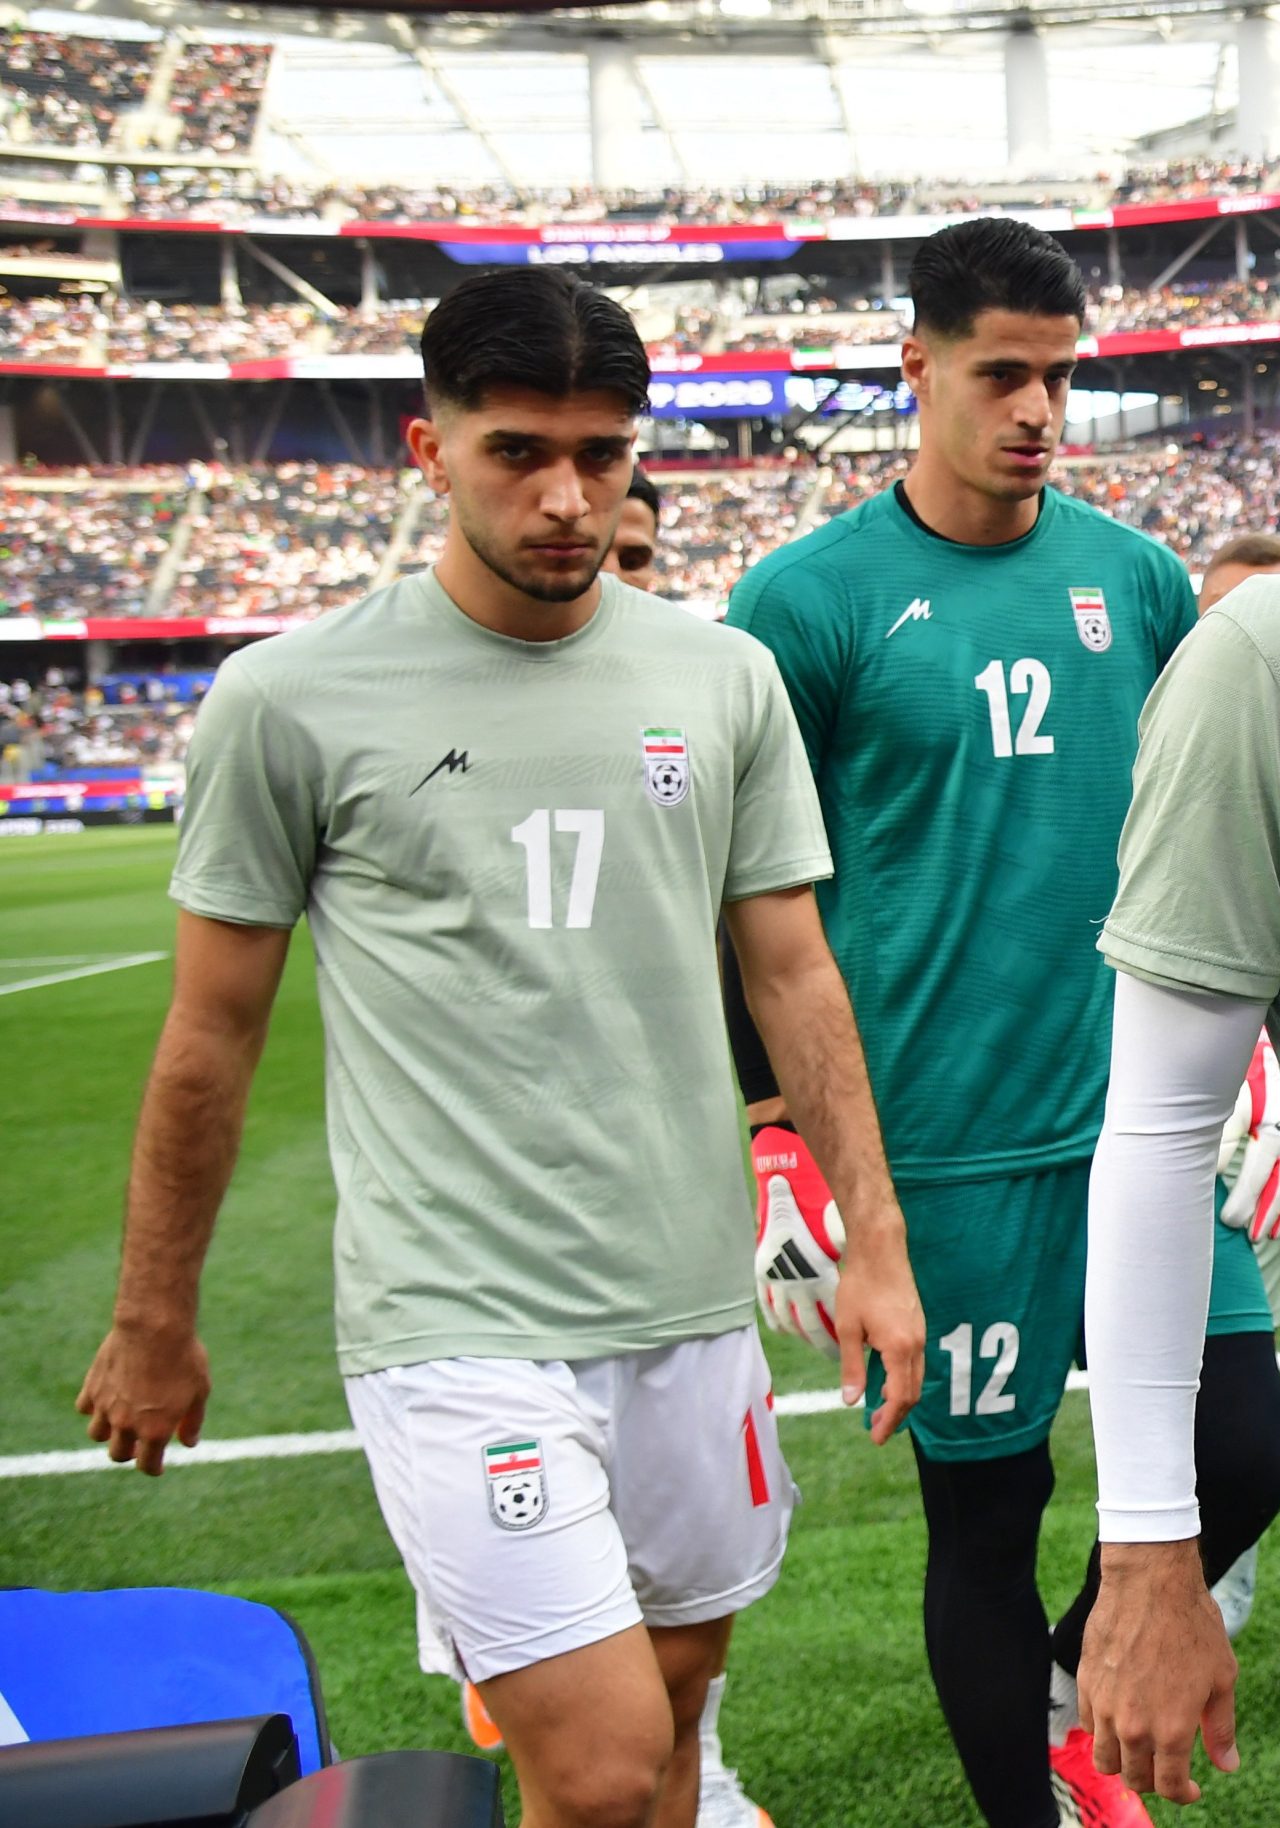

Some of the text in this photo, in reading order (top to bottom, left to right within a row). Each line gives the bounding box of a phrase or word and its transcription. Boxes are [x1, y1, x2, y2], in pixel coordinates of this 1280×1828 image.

[527, 243, 724, 264] LOS ANGELES
[674, 380, 773, 408] 2026
[974, 657, 1055, 758] 12
[511, 808, 605, 929] 17
[939, 1321, 1020, 1416] 12
